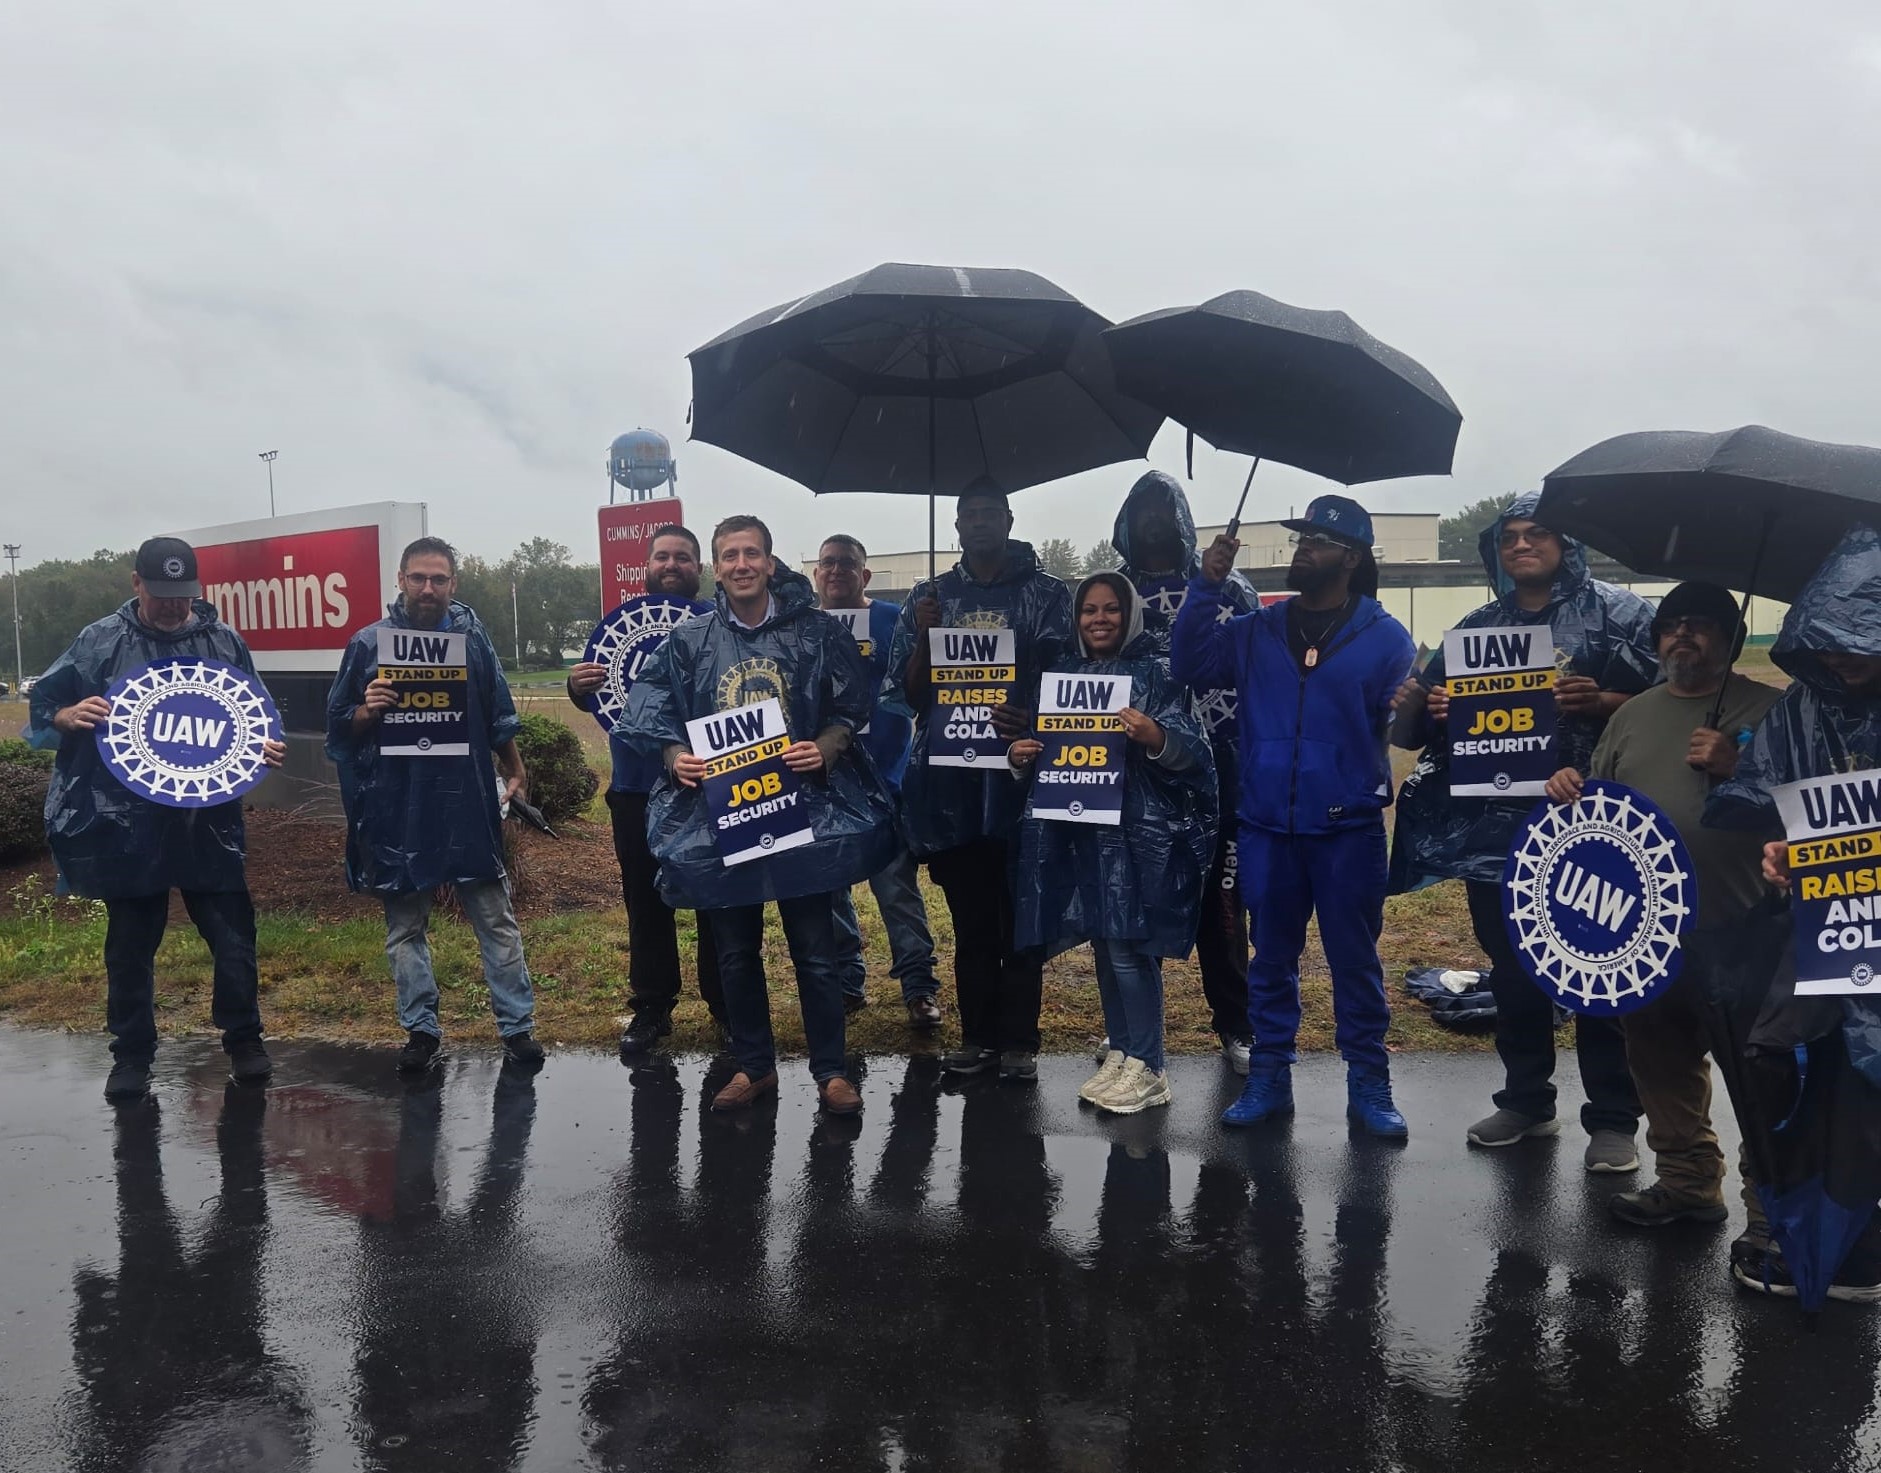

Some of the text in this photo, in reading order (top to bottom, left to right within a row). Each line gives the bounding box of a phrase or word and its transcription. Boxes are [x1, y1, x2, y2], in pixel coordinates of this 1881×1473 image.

[606, 521, 674, 544] CUMMINS/JAC
[201, 555, 349, 630] mmins
[393, 634, 450, 664] UAW
[944, 634, 998, 662] UAW
[1463, 633, 1532, 669] UAW
[384, 669, 460, 679] STAND UP
[937, 668, 1009, 680] STAND UP
[1453, 674, 1548, 694] STAND UP
[397, 691, 450, 708] JOB
[937, 688, 1008, 705] RAISES
[1056, 680, 1115, 710] UAW
[383, 711, 463, 724] SECURITY
[950, 706, 993, 722] AND
[1043, 718, 1121, 729] STAND UP
[1467, 707, 1535, 735] JOB
[152, 711, 227, 748] UAW
[704, 708, 765, 751] UAW
[944, 723, 997, 739] COLA
[705, 741, 784, 776] STAND UP
[1052, 745, 1108, 767] JOB
[1452, 735, 1552, 756] SECURITY
[727, 772, 783, 807] JOB
[1038, 770, 1120, 785] SECURITY
[717, 791, 798, 830] SECURITY
[1800, 778, 1881, 830] UAW
[1548, 826, 1579, 854] AEROSPACE
[1600, 823, 1645, 858] AGRICULTURAL
[1797, 837, 1873, 863] STAND
[1555, 860, 1637, 933] UAW
[1644, 860, 1658, 907] IMPLEMENT
[1801, 866, 1881, 901] RAIS
[1824, 895, 1881, 925] AN
[1536, 910, 1551, 939] UNITED
[1639, 911, 1657, 949] WORKERS
[1817, 924, 1881, 953] COL
[1597, 956, 1628, 972] AMERICA
[1630, 948, 1639, 959] OF
